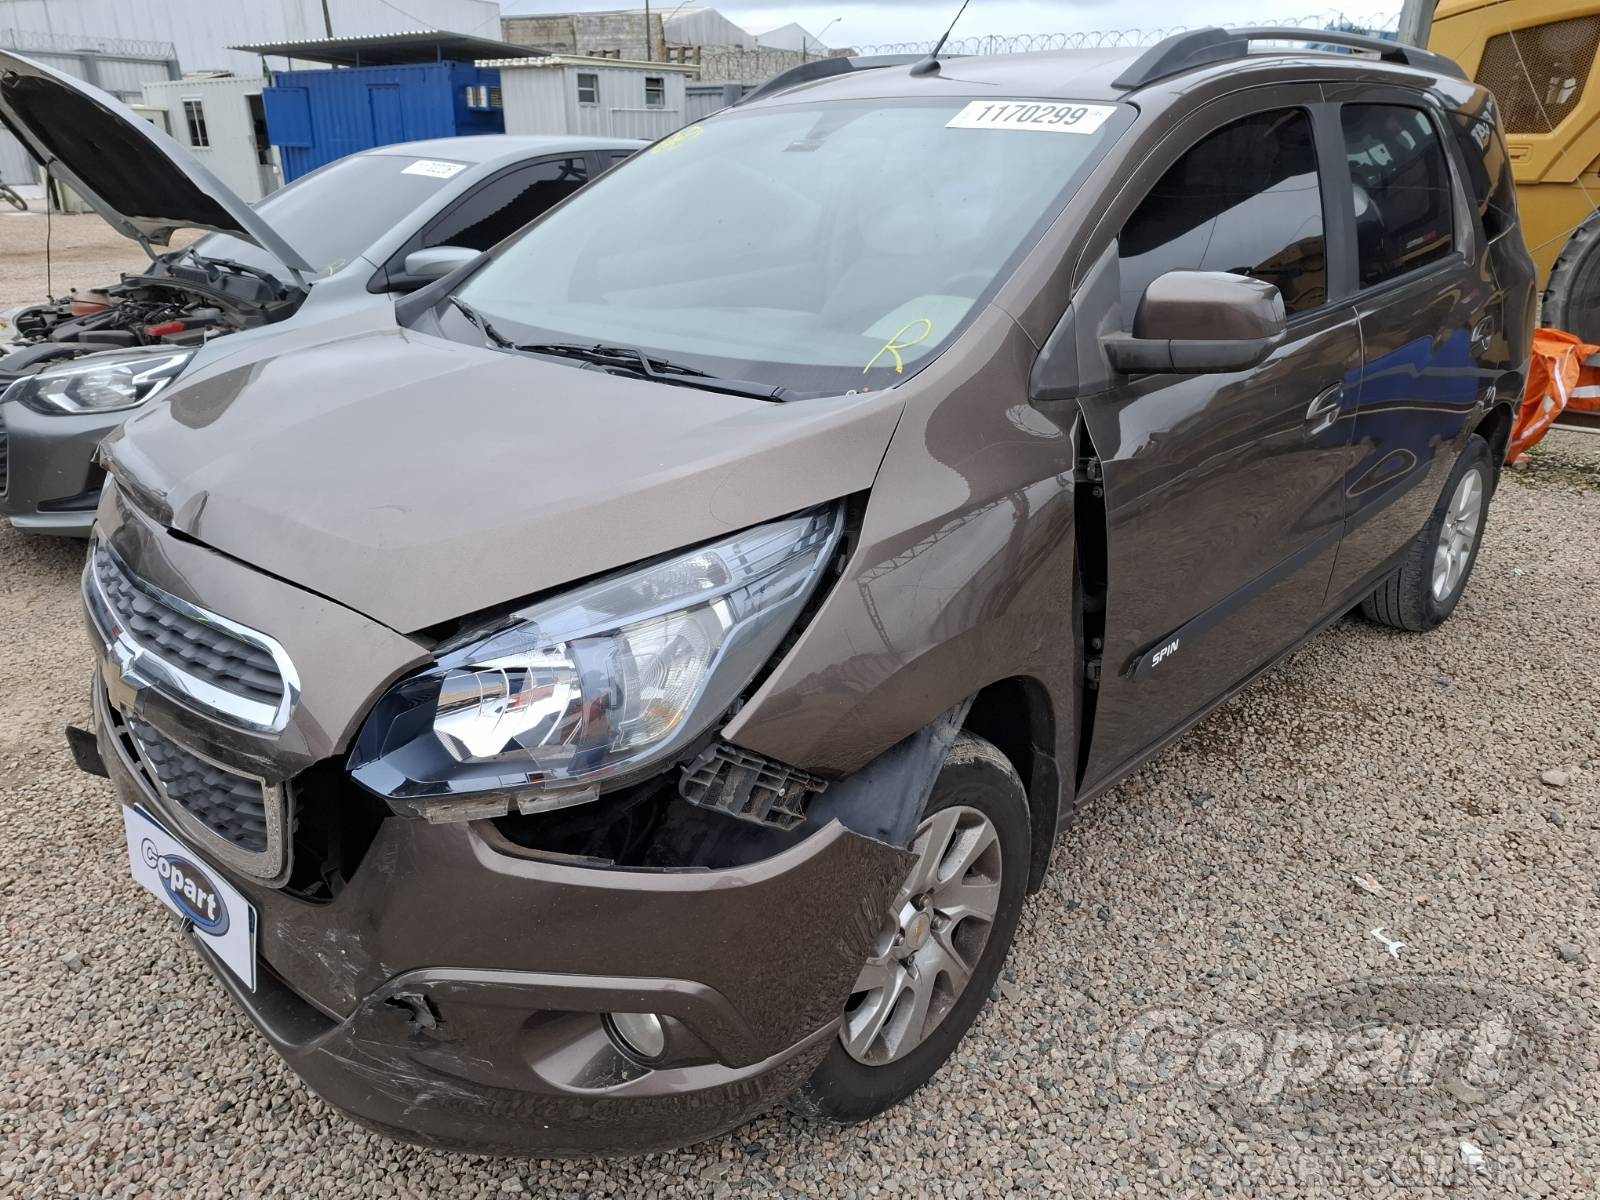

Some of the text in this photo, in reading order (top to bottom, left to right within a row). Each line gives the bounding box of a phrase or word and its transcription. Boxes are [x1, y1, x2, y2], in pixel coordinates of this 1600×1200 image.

[976, 104, 1089, 126] 1170299
[863, 318, 932, 375] R
[1151, 638, 1180, 668] SPIN
[141, 837, 217, 921] Copart
